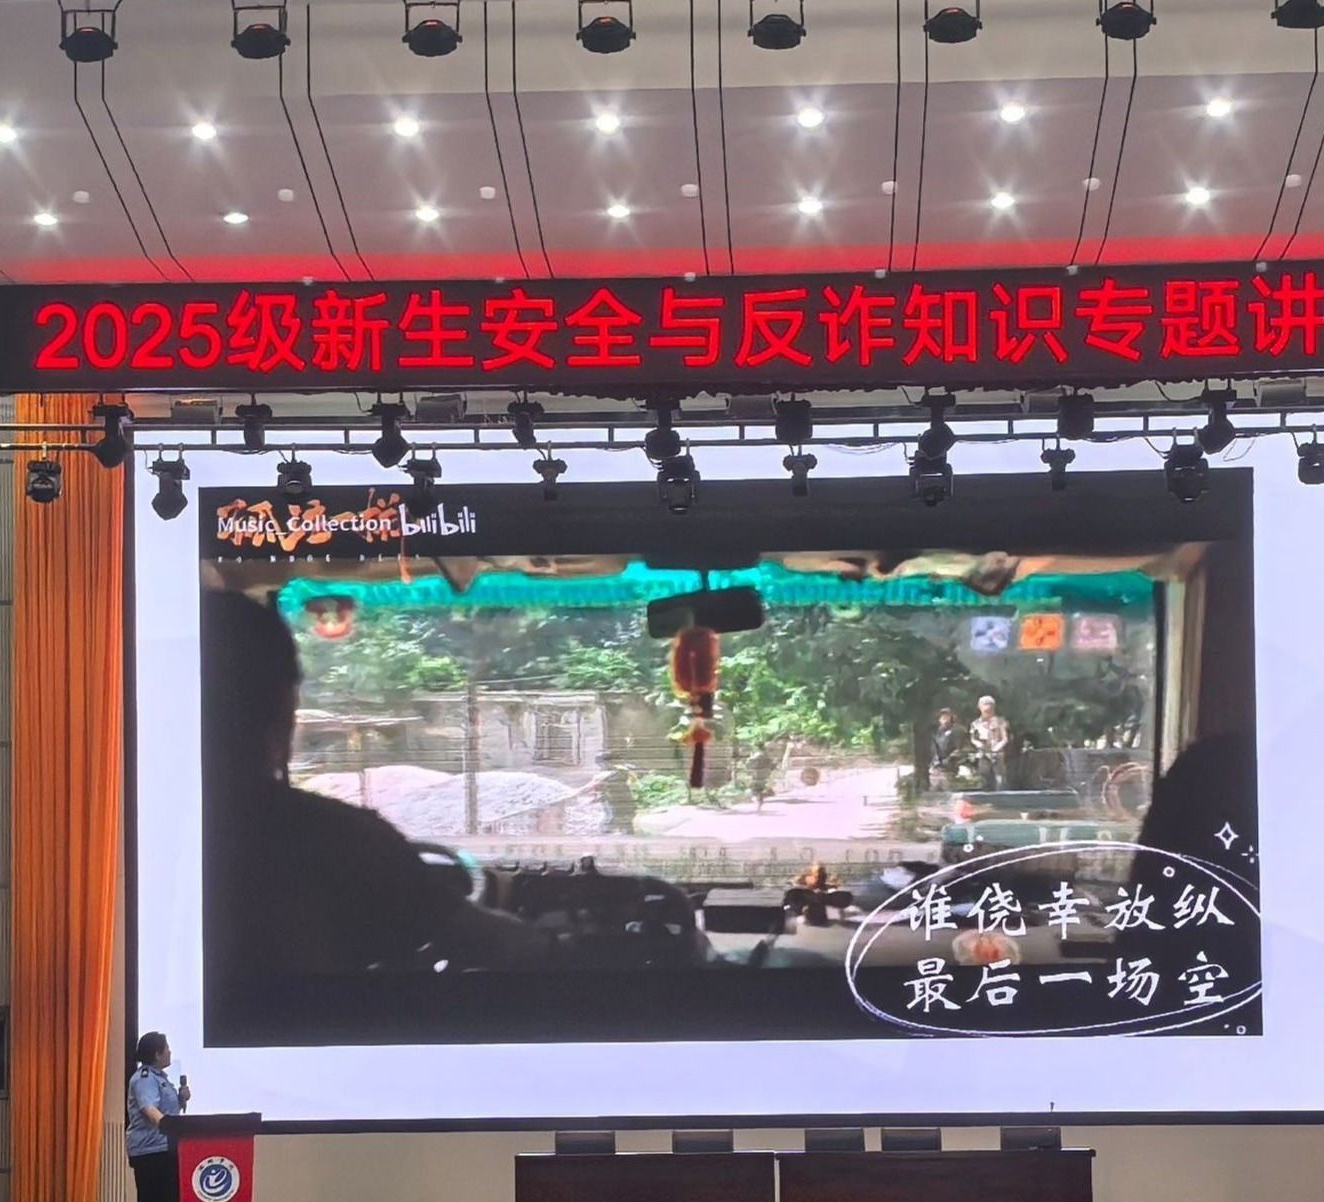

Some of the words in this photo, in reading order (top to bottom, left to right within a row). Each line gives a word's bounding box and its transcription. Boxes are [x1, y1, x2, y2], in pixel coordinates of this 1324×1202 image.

[398, 503, 477, 537] bilibili
[900, 881, 1236, 942] 谁侥幸放纵
[902, 951, 1231, 1014] 最后一场空
